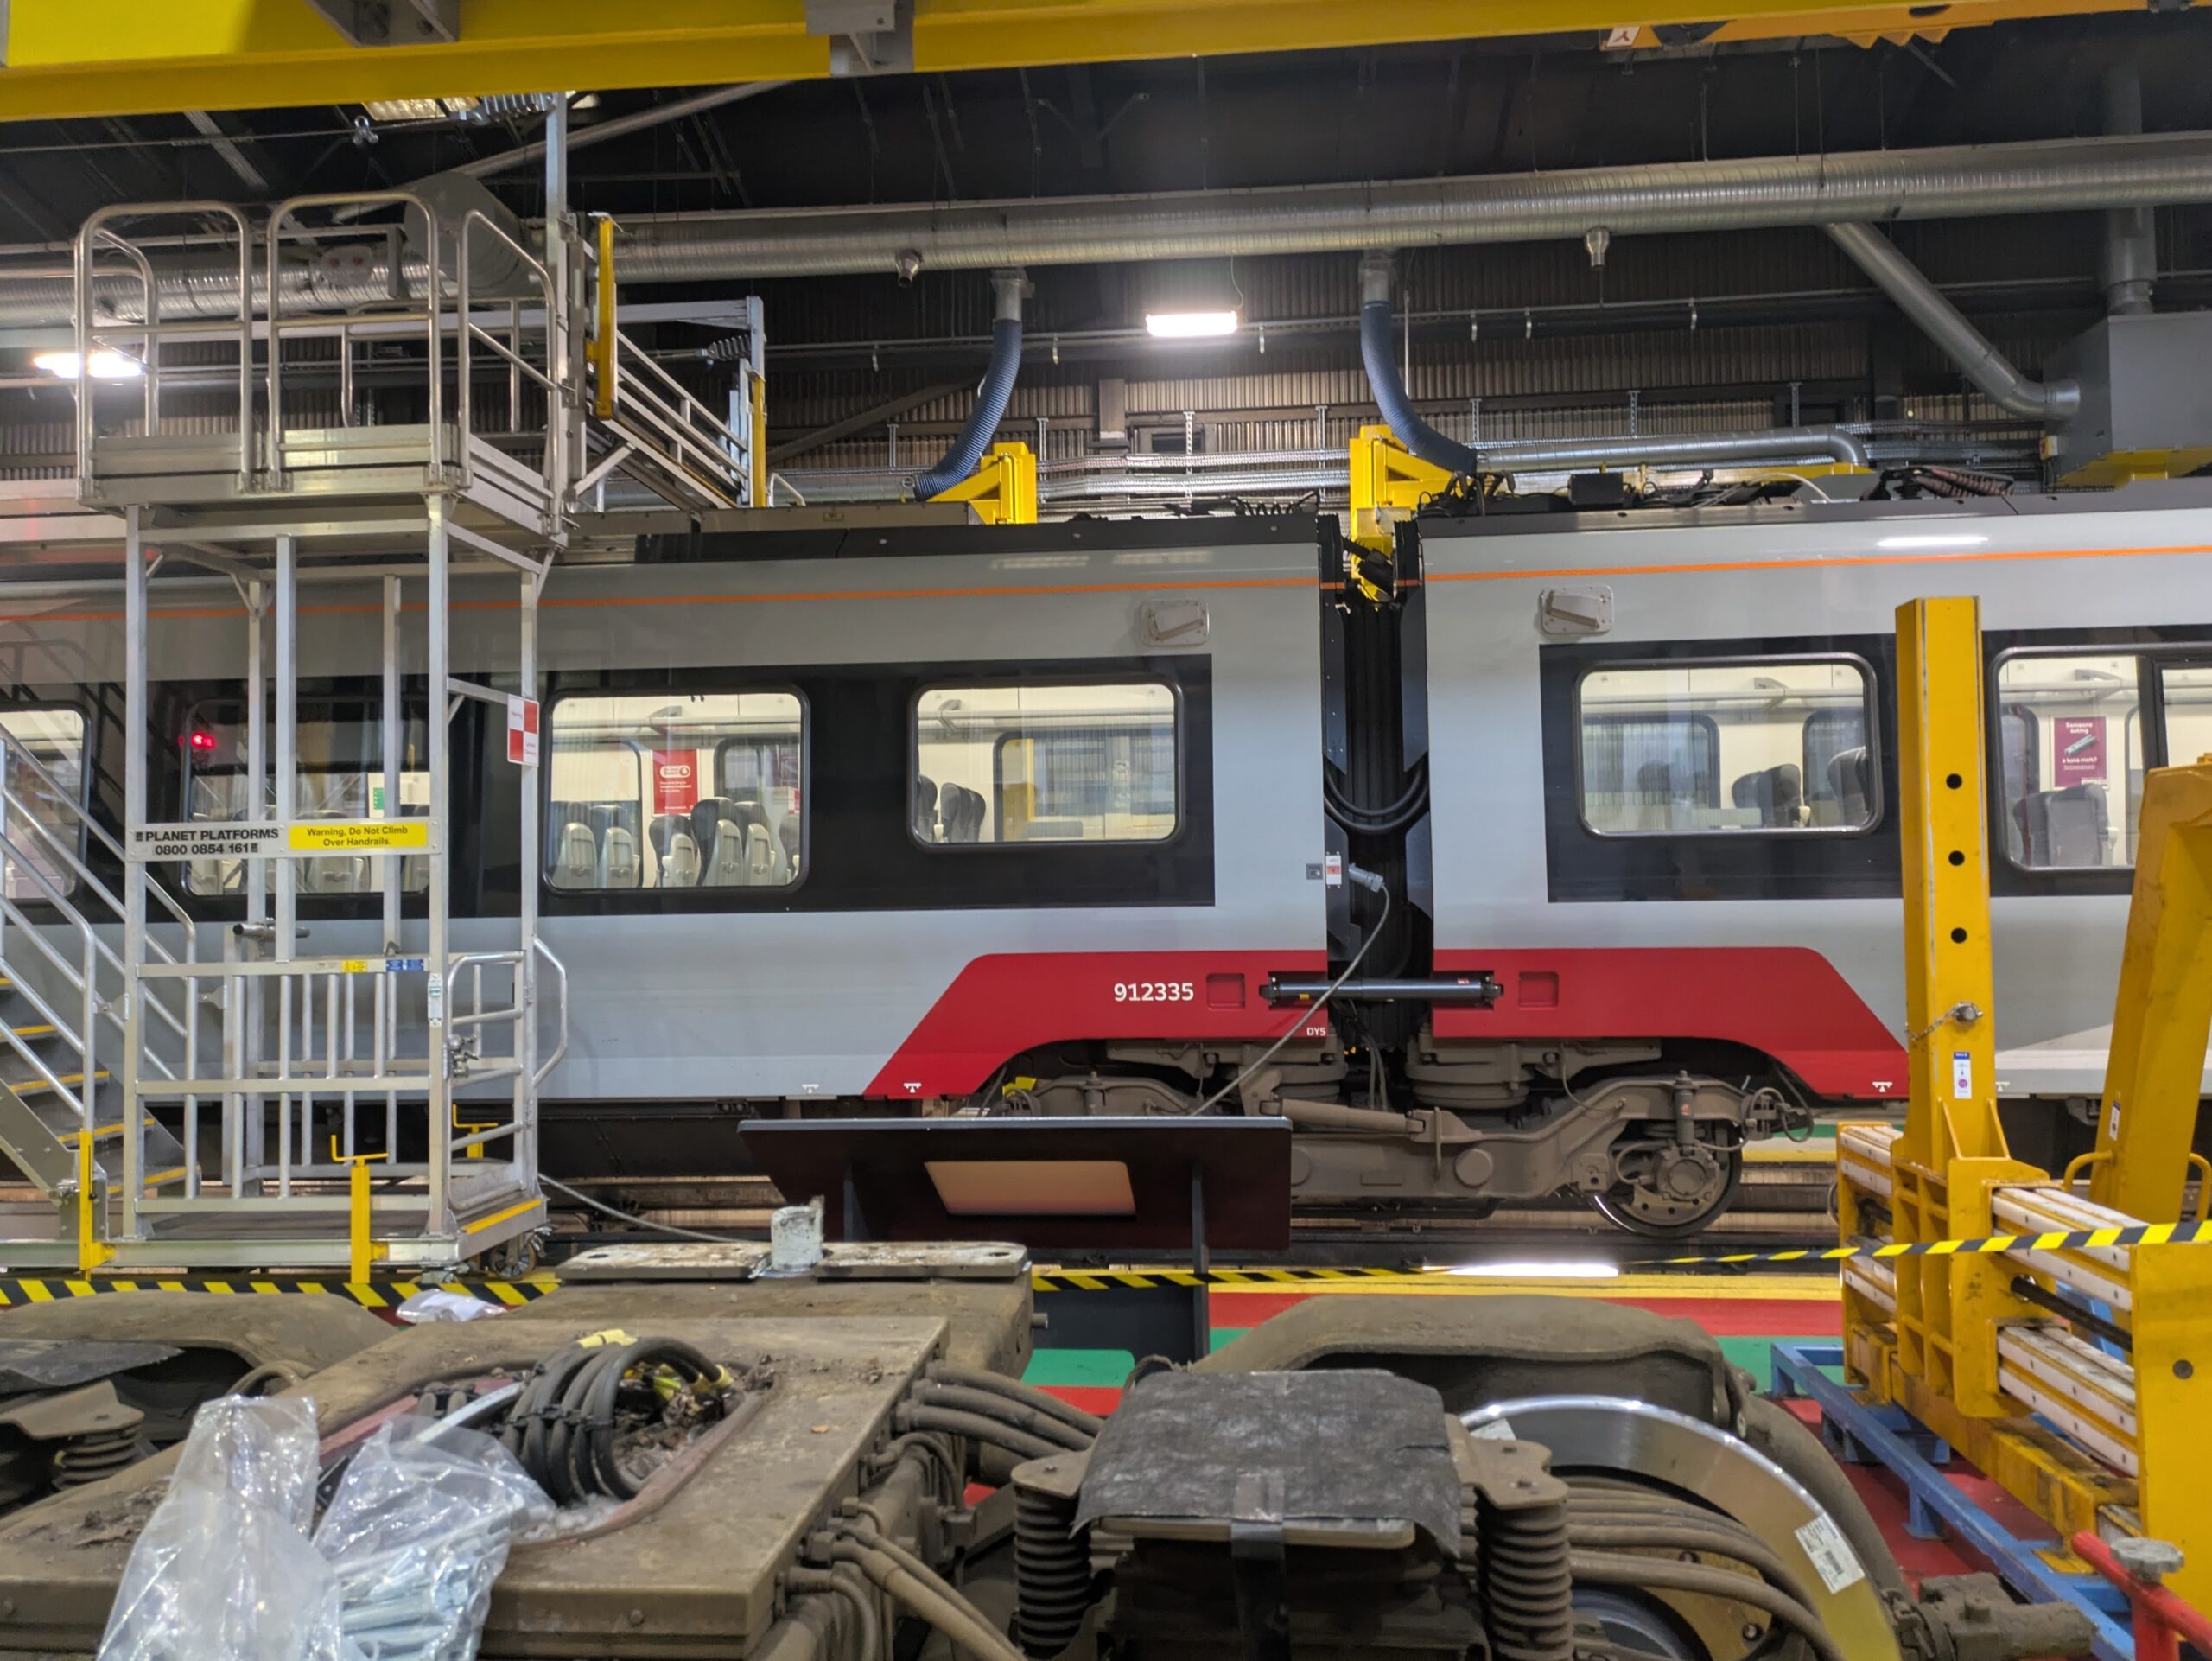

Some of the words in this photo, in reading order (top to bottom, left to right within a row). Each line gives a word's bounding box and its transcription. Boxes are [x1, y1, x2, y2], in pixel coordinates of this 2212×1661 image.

[145, 830, 197, 842] PLANET
[200, 828, 279, 842] PLATFORMS
[349, 826, 361, 835] Do
[364, 826, 380, 835] Not
[381, 825, 408, 835] Climb
[323, 838, 344, 847] Over
[346, 837, 391, 846] Handrails.
[155, 844, 188, 856] 0800
[191, 843, 225, 855] 0854
[1114, 982, 1194, 1002] 912335
